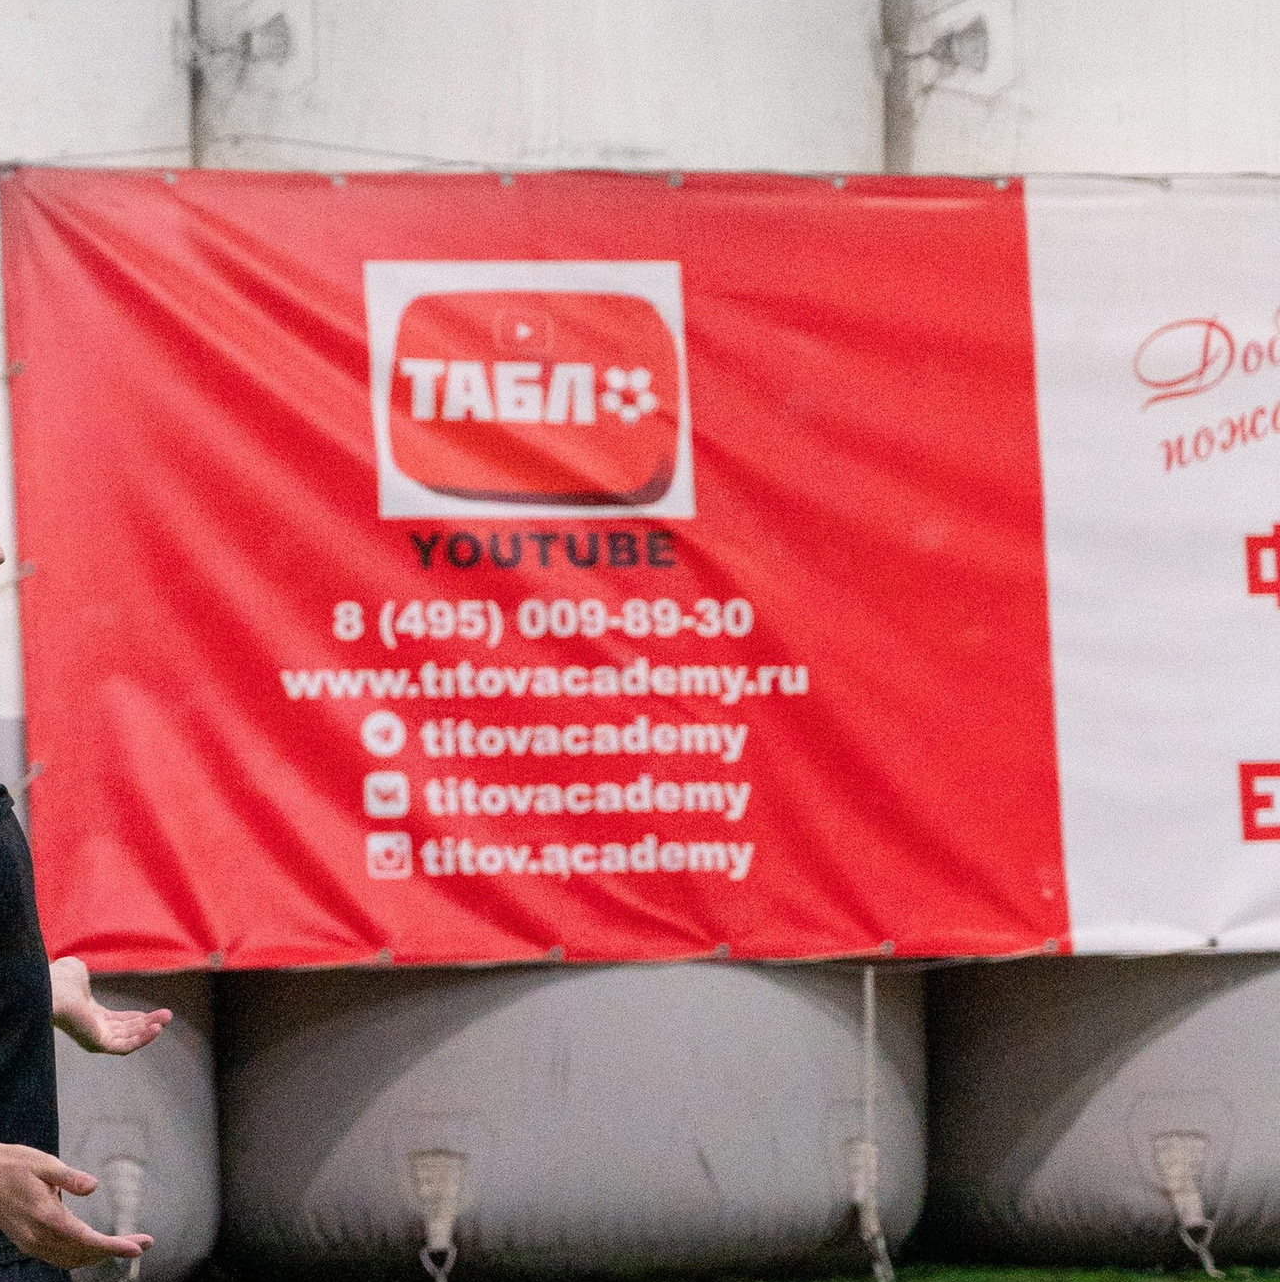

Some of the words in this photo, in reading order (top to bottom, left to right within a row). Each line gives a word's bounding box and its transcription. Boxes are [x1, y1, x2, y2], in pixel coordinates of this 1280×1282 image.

[410, 529, 677, 570] YOUTUBE
[332, 600, 365, 642] 8
[379, 598, 505, 650] (495)
[517, 597, 754, 639] 009-89-30
[280, 655, 809, 706] www.titovacademy.ru
[421, 715, 749, 764] titovacademy
[425, 773, 751, 821] titovacademy
[421, 833, 755, 882] titov.academy
